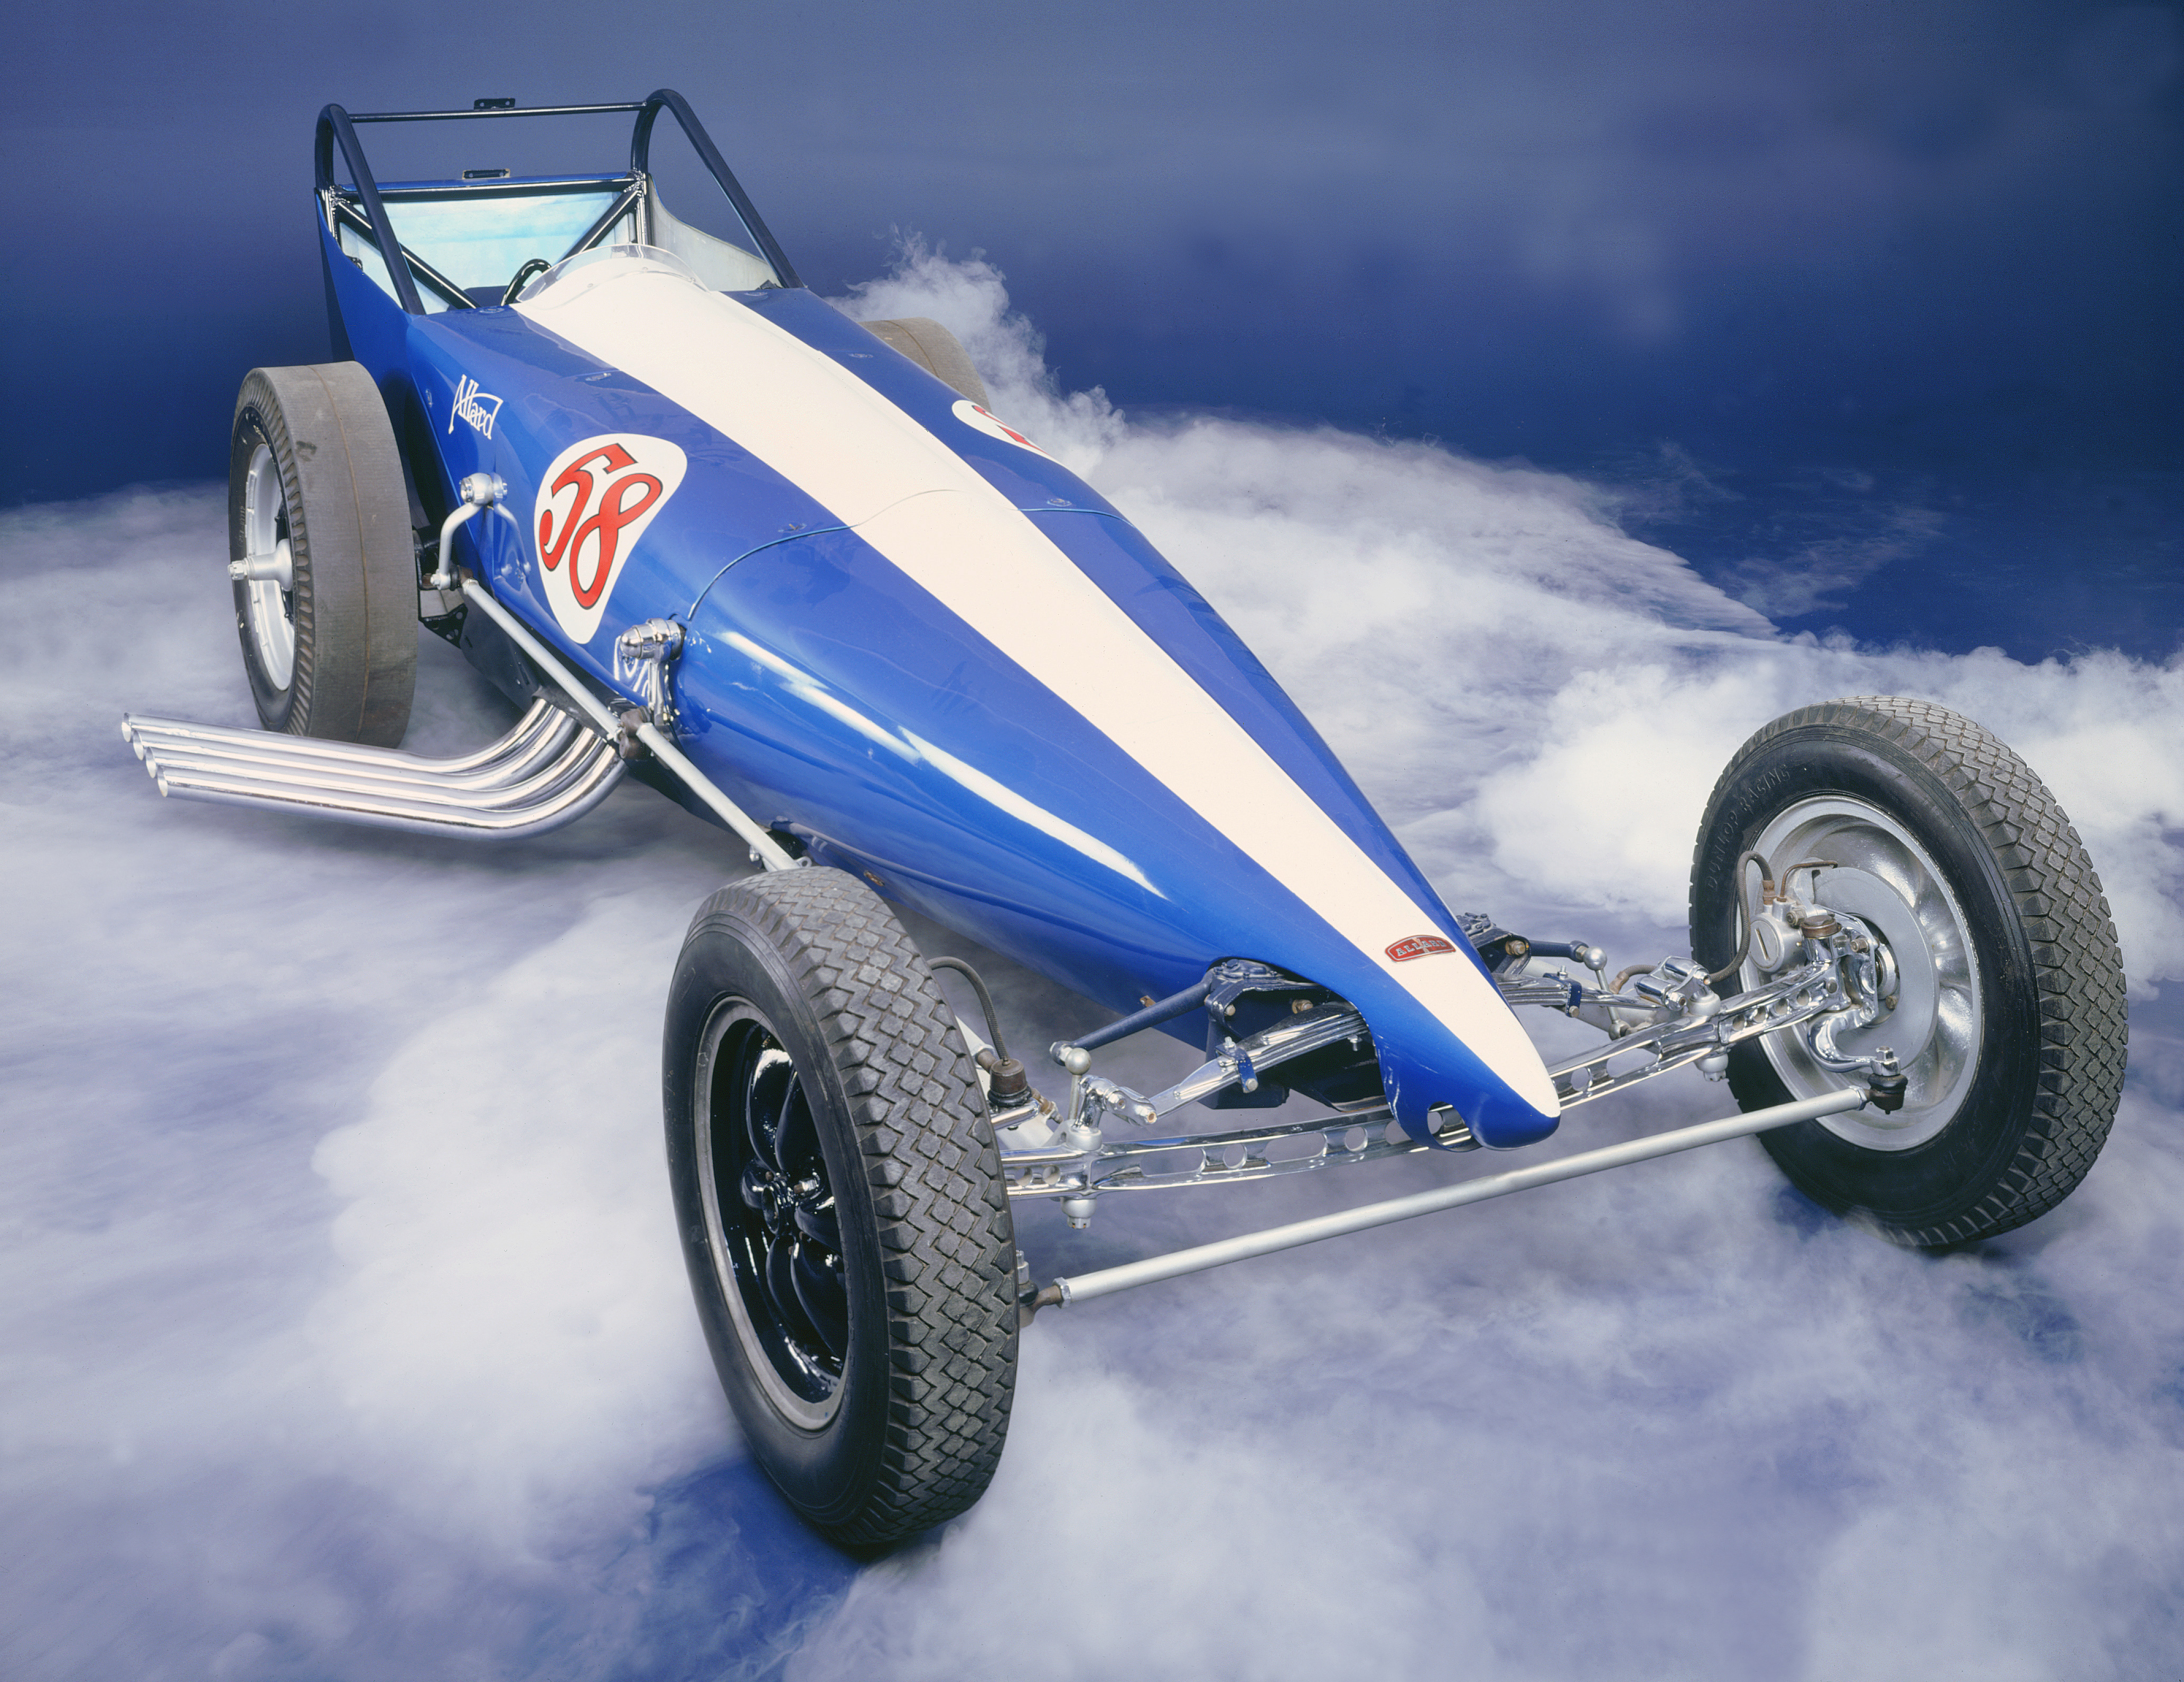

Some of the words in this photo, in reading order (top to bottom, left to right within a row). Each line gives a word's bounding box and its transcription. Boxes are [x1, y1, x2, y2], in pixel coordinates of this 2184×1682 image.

[448, 374, 503, 440] Allard
[539, 442, 663, 610] 58
[1395, 940, 1447, 956] ALLARD
